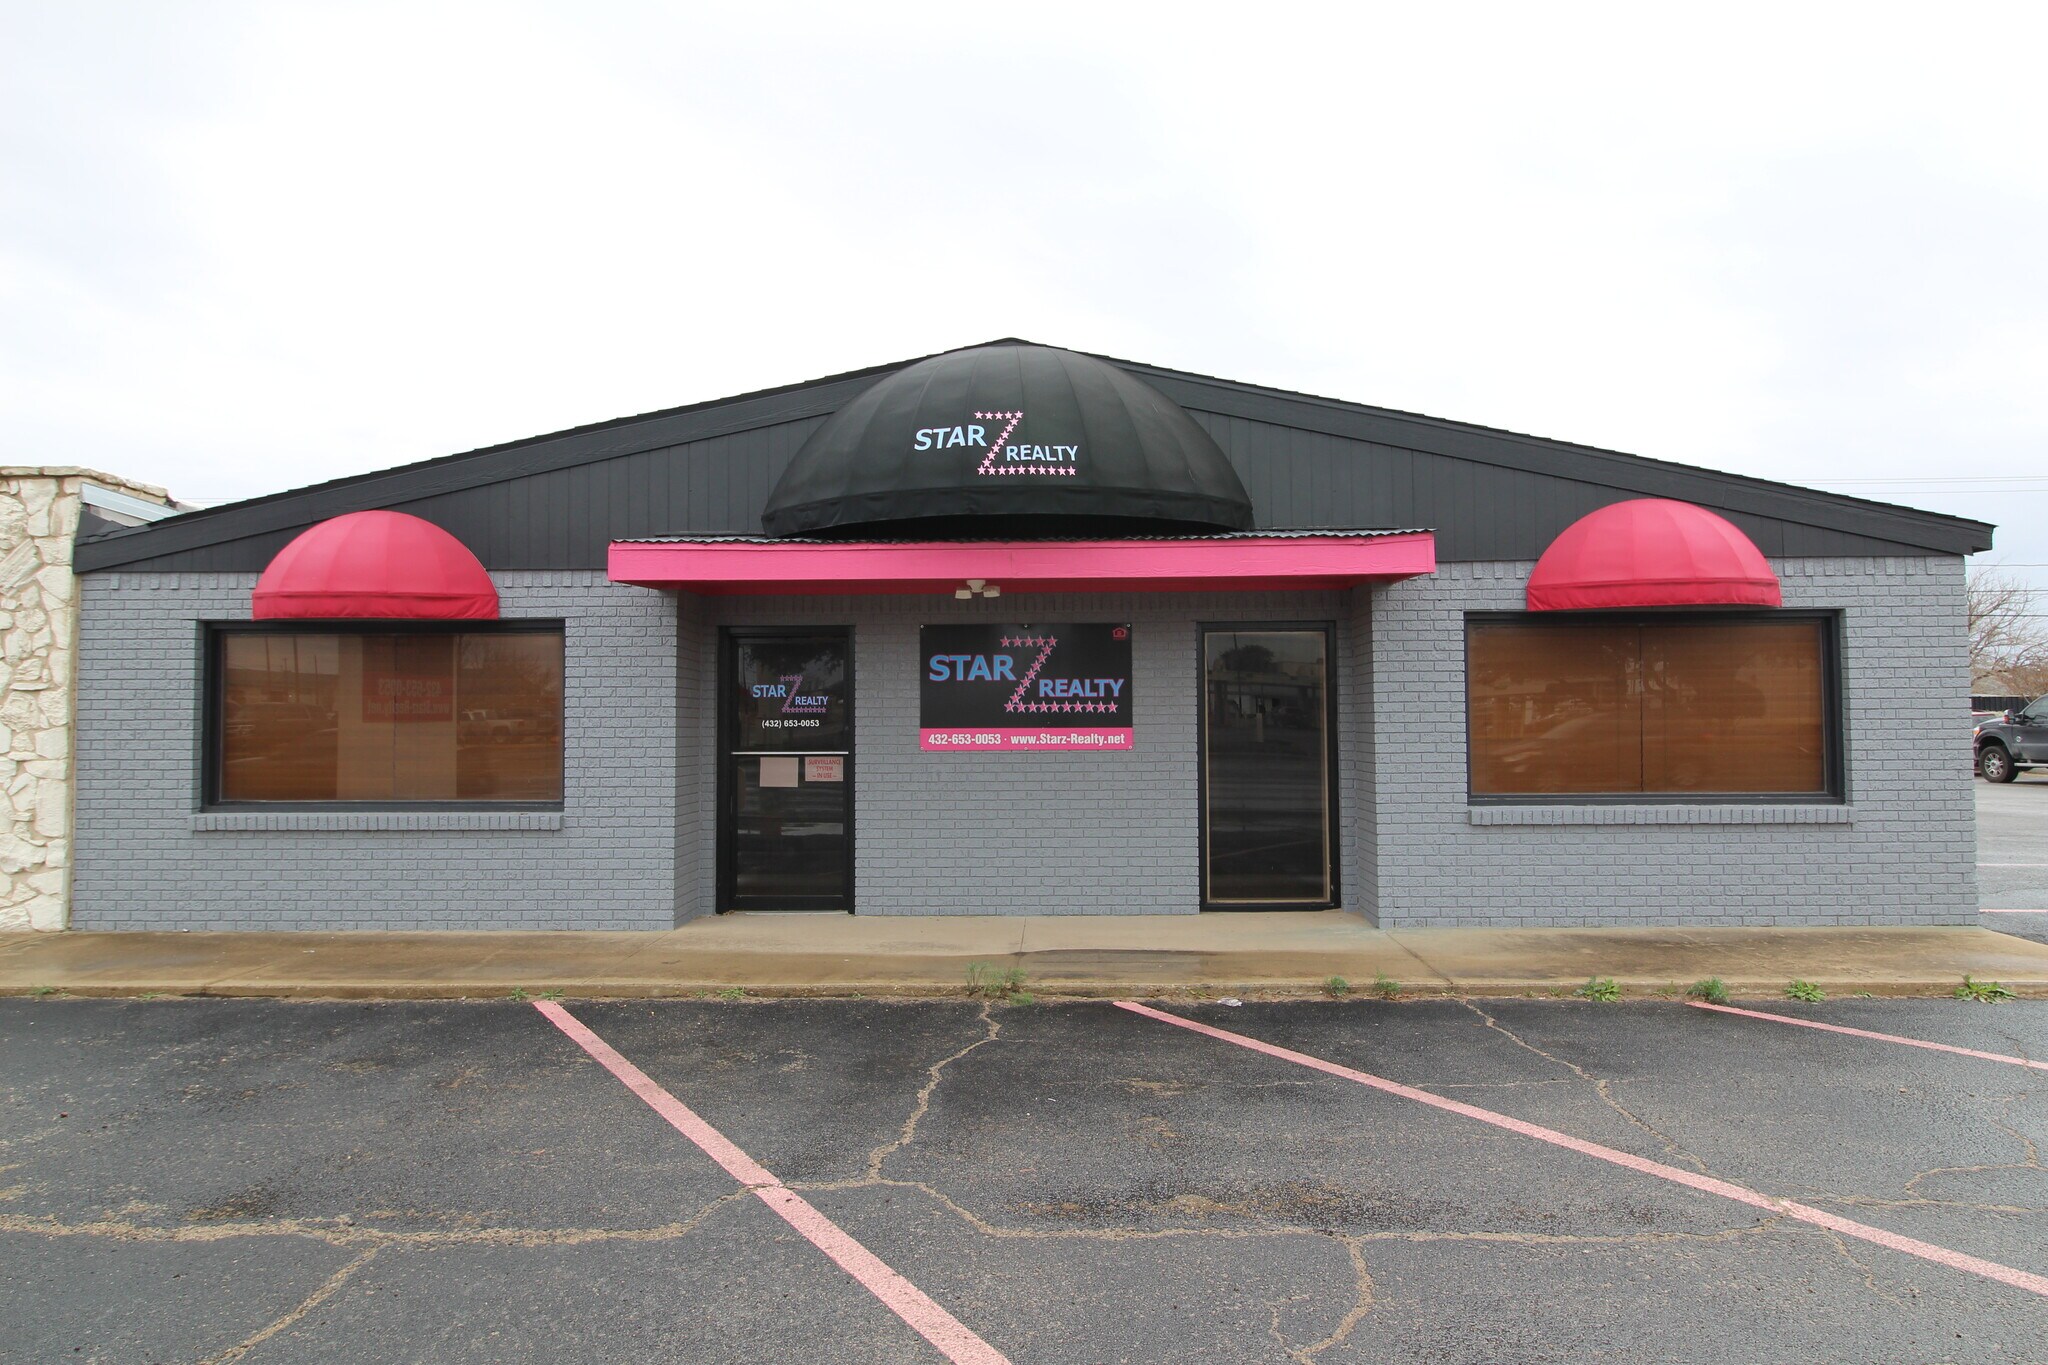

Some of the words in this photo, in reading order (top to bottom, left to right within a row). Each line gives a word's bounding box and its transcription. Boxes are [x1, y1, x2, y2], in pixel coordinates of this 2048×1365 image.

[914, 424, 987, 451] STAR
[1006, 444, 1078, 462] REALTY
[929, 655, 1017, 681] STAR
[1039, 678, 1124, 698] REALTY
[752, 684, 787, 698] STAR
[795, 696, 829, 706] REALTY
[761, 719, 782, 729] (432)
[784, 719, 820, 728] 653-0053
[928, 733, 1001, 745] 432-653-0053
[1010, 733, 1125, 747] www.Starz-Realty.net
